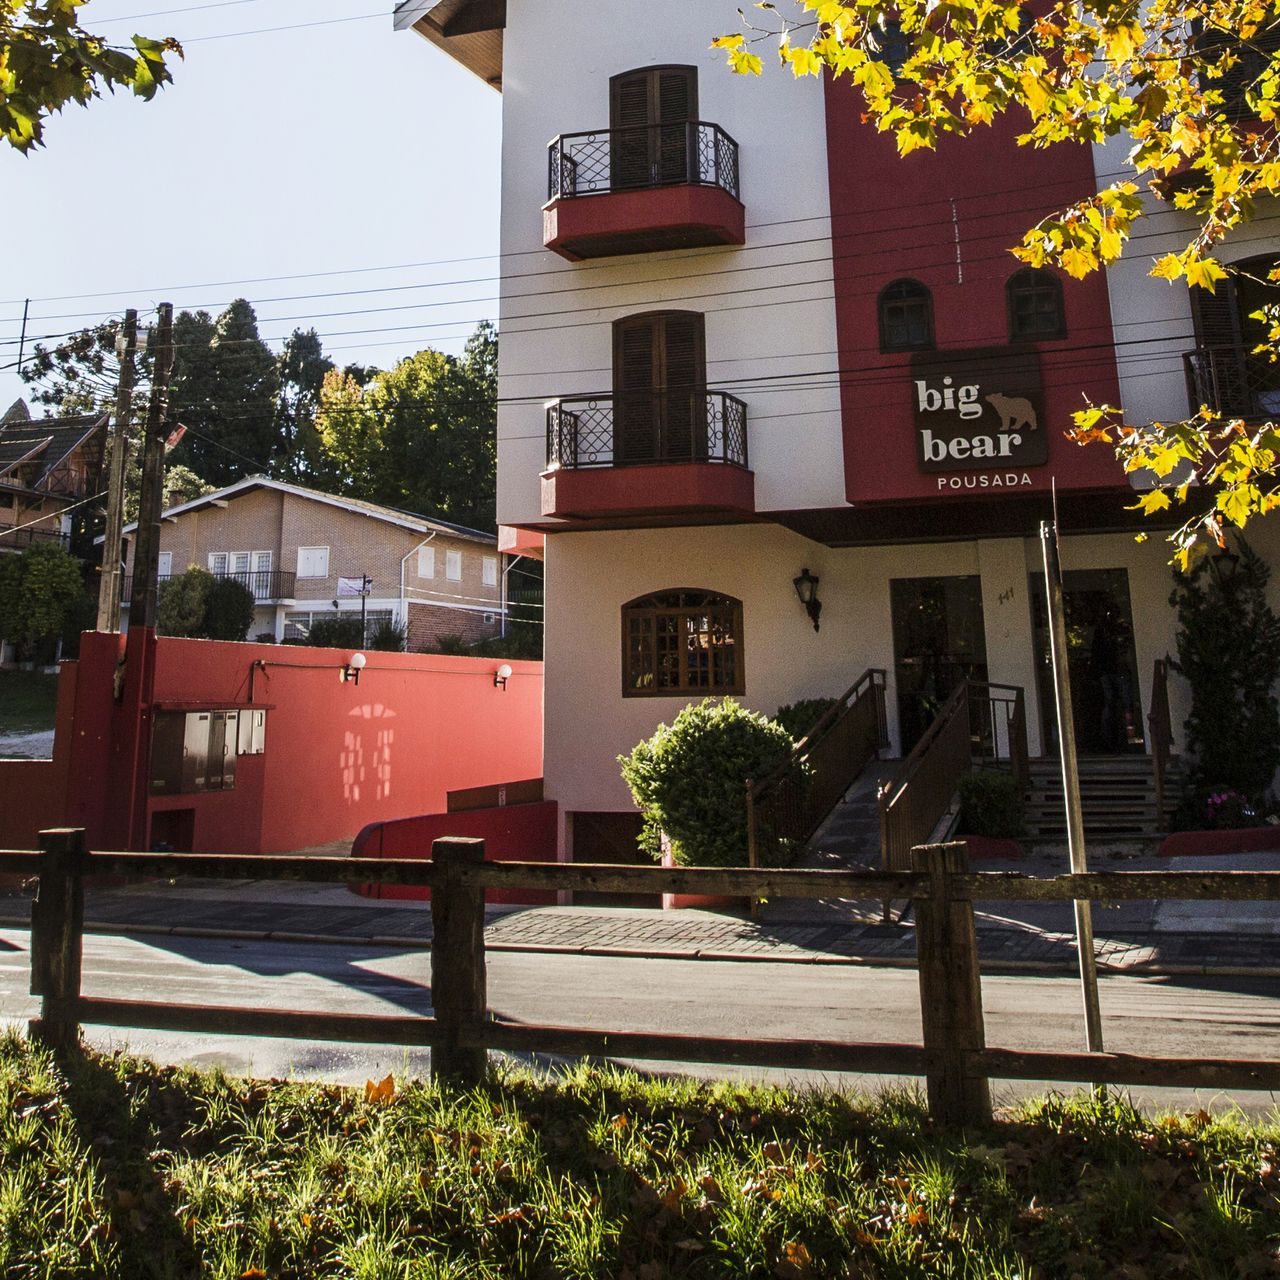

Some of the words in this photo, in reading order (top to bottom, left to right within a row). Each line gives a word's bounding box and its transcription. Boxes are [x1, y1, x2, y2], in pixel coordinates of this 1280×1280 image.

[914, 376, 983, 419] big
[920, 429, 1022, 462] bear
[937, 473, 1032, 490] POUSADA
